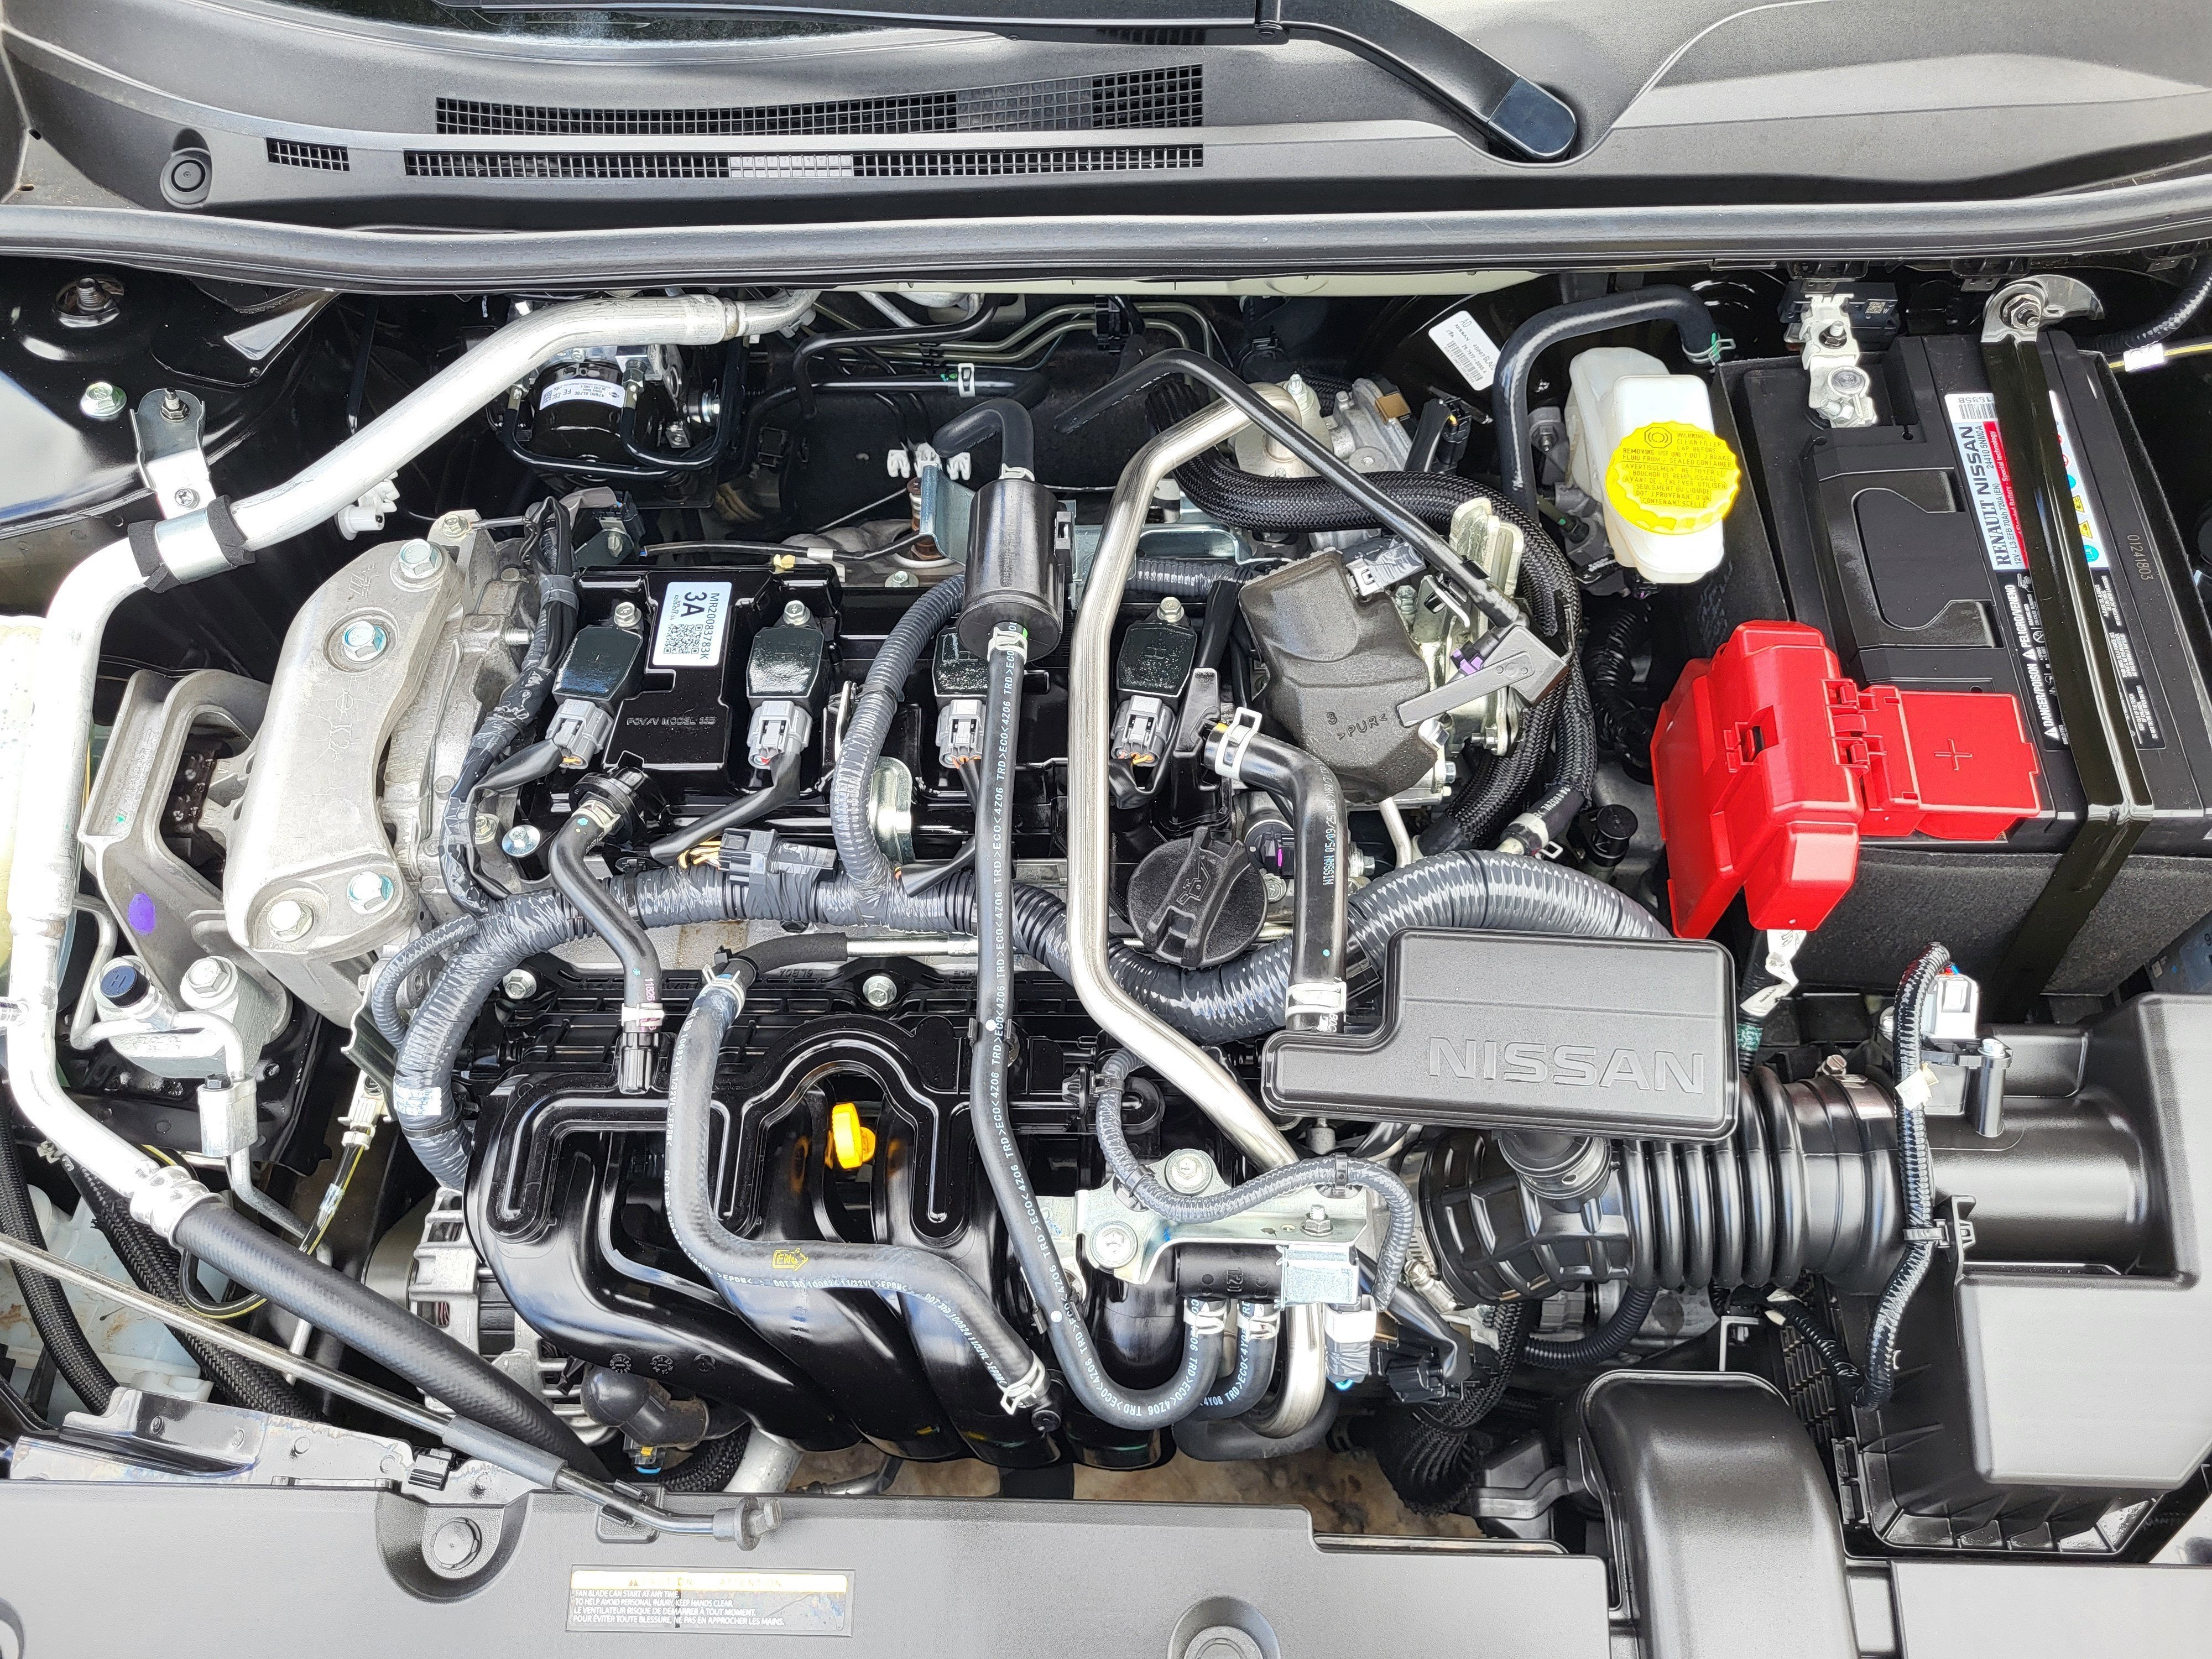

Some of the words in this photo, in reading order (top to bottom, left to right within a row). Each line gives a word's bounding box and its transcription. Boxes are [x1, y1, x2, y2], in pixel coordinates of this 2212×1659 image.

[1958, 426, 1991, 495] NISSAN
[1981, 450, 1994, 469] 24410
[1989, 431, 2003, 461] technology
[1625, 464, 1677, 472] AVERTISSEMENT
[1672, 473, 1717, 482] REMPLISSAGE
[1997, 462, 2011, 482] Special
[1992, 483, 2002, 495] (EN)
[1997, 497, 2007, 511] 720A
[2006, 486, 2015, 506] Battery
[1979, 500, 2012, 566] RENAULT
[2001, 512, 2010, 527] 70Ah
[2005, 528, 2015, 540] EFB
[2013, 554, 2022, 565] 12V
[680, 591, 707, 617] 3A
[2005, 585, 2032, 648] PELIGRO/VENENO
[700, 593, 720, 659] MR20083783K
[2026, 664, 2054, 727] DANGER/POISON
[997, 700, 1011, 780] TRD>ECO<4Z06
[1326, 799, 1336, 812] MEX
[993, 786, 1004, 885] TRD>ECO<4Z06
[1324, 815, 1337, 853] 05/09/25
[1322, 854, 1335, 885] NISSAN
[994, 891, 1004, 978] TRD>ECO<4Z06
[674, 1033, 688, 1068] 100824
[1428, 1036, 1705, 1094] NISSAN
[669, 1071, 680, 1108] 11/32VL
[666, 1111, 675, 1147] >EPDM<
[990, 1071, 1014, 1159] TRD>ECO<4Z06
[1010, 1164, 1051, 1259] TRD>ECO<4Z06
[717, 1272, 753, 1285] >EPDM<
[773, 1279, 789, 1287] DOT
[807, 1280, 839, 1289] 100824
[840, 1280, 874, 1288] 11/32VL
[876, 1280, 908, 1292] >EPDM<
[924, 1293, 941, 1305] DOT
[948, 1313, 973, 1337] 100824
[967, 1337, 990, 1360] 11/32VL
[1084, 1357, 1142, 1416] TRD>ECO<4Z06
[1148, 1357, 1198, 1416] TRD>ECO<4Z06
[653, 1599, 675, 1607] INJURY,
[662, 1606, 699, 1615] DÉMARRER
[700, 1606, 705, 1615] À
[593, 1614, 615, 1623] ÉVITER
[639, 1616, 672, 1624] BLESSURE,
[761, 1618, 785, 1626] MAINS.
